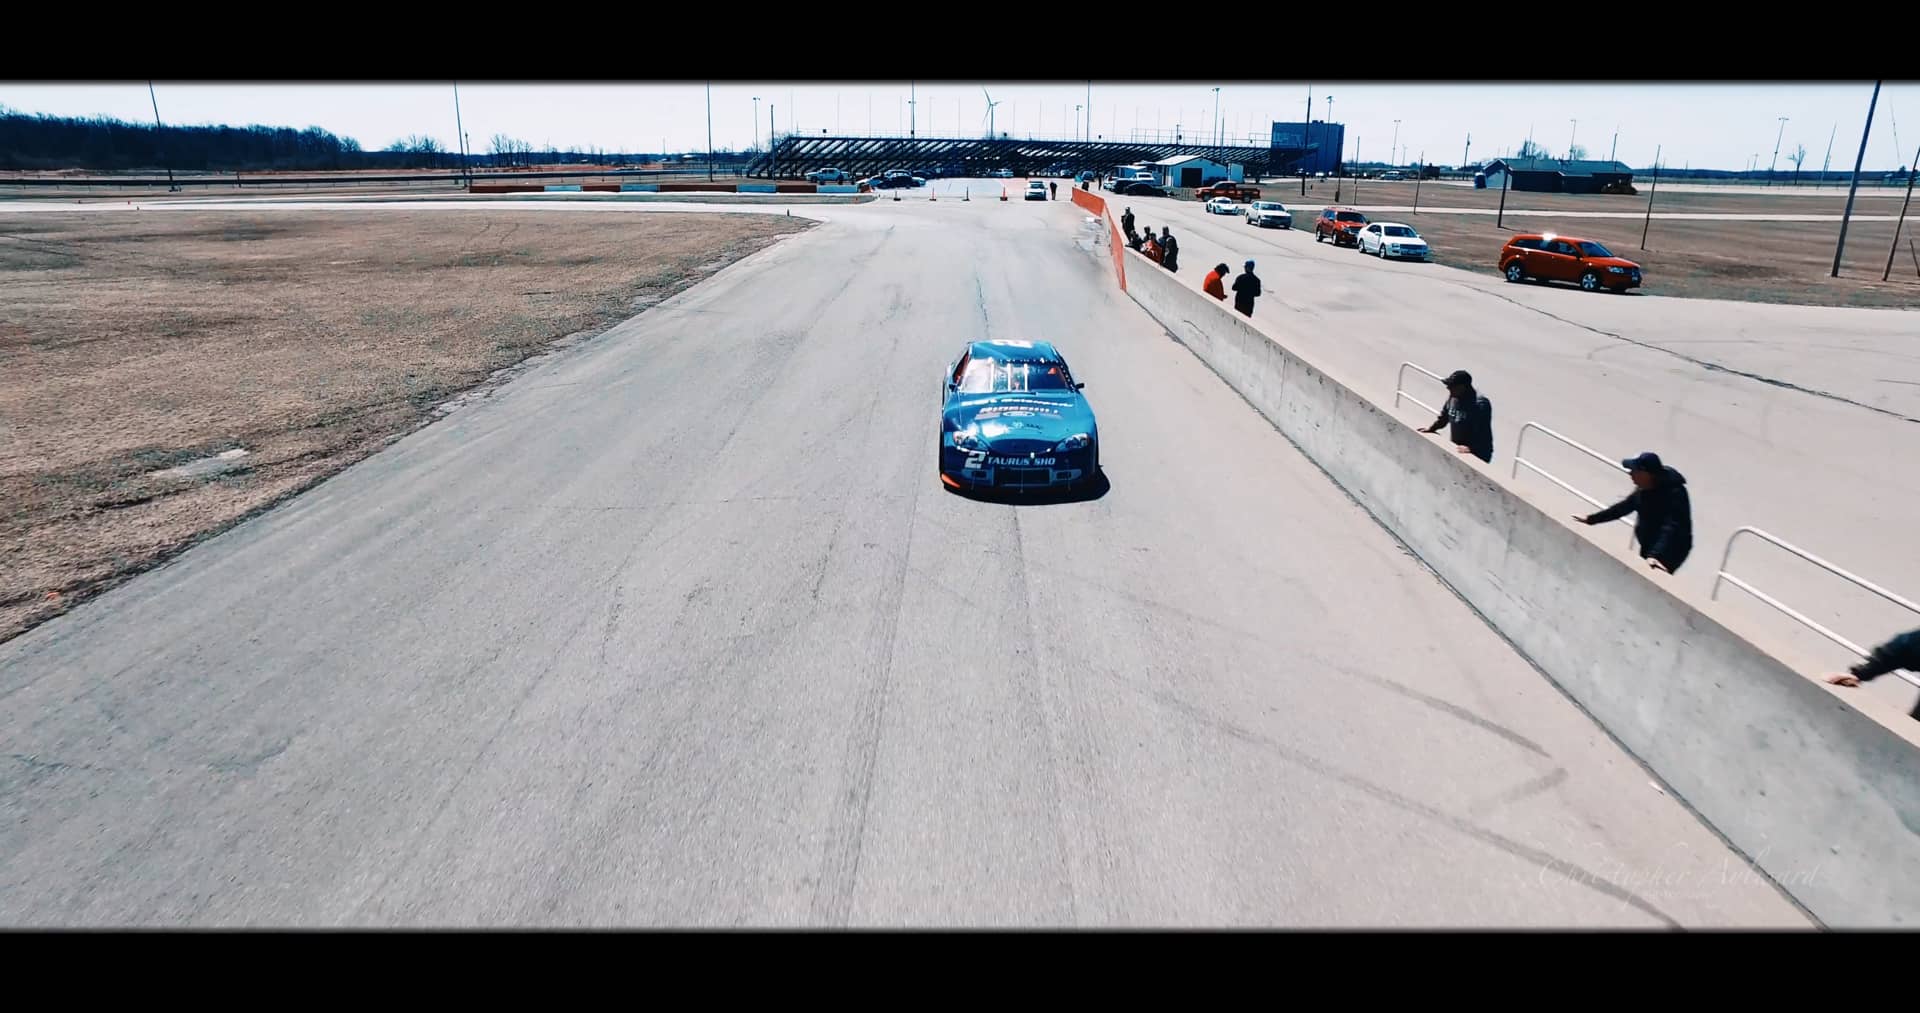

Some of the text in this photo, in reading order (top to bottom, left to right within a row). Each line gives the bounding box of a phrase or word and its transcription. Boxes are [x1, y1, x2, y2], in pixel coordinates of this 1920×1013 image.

[964, 450, 987, 469] 2
[987, 456, 1056, 466] TAURUS SHO
